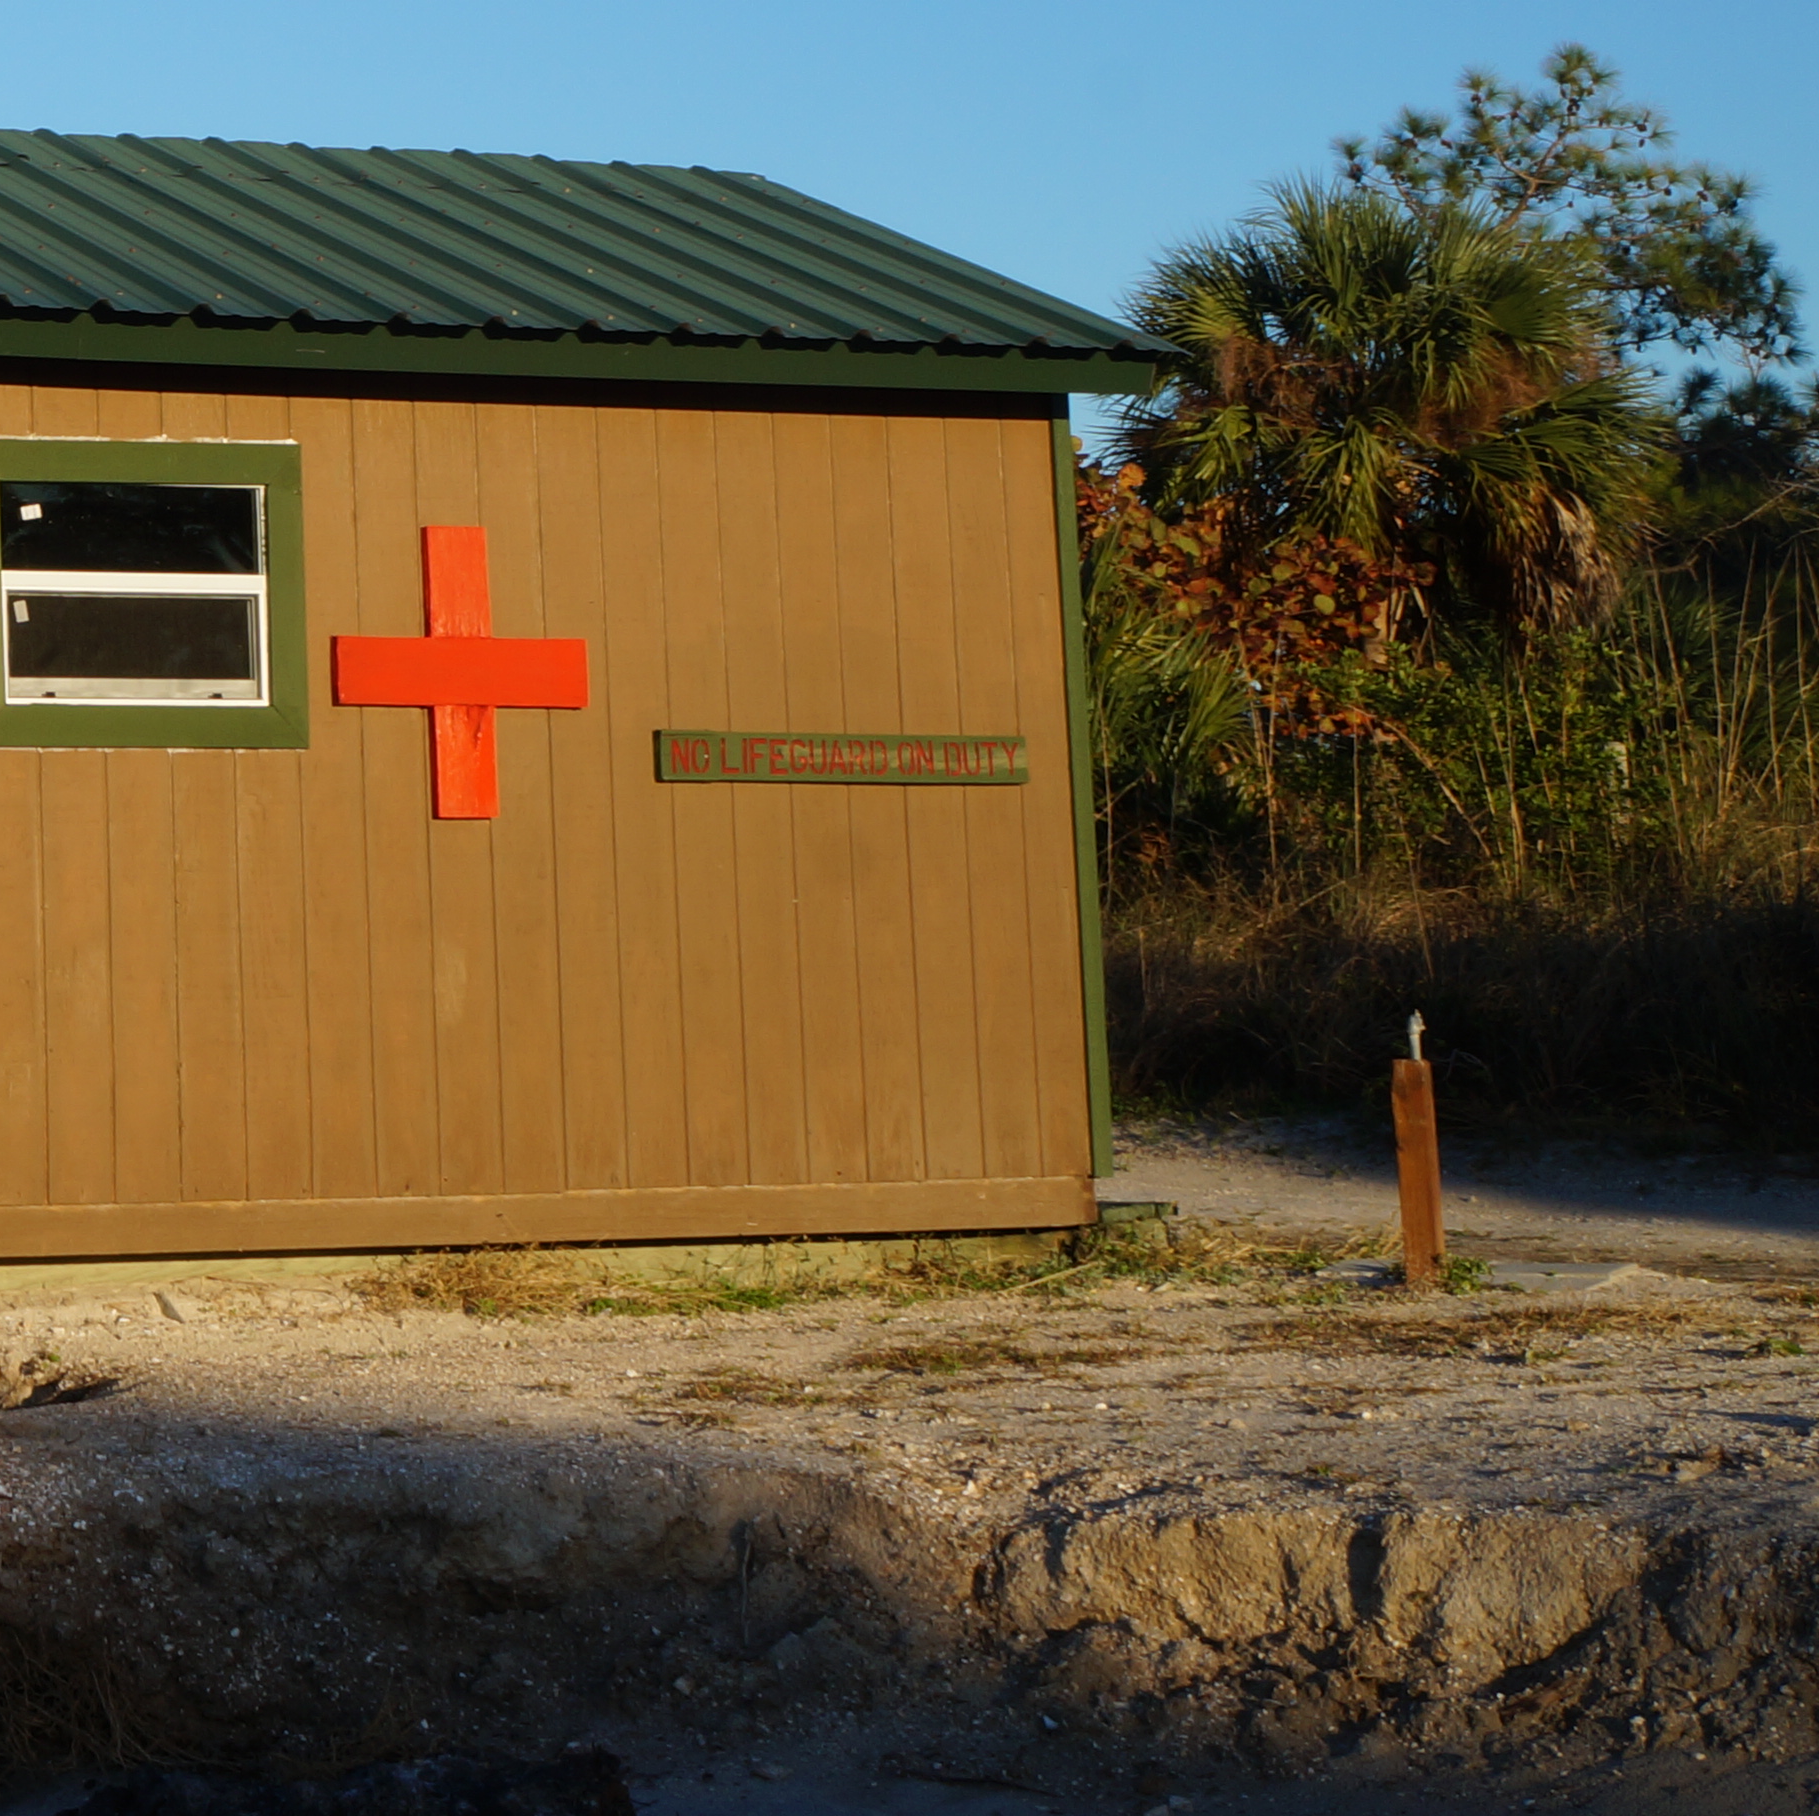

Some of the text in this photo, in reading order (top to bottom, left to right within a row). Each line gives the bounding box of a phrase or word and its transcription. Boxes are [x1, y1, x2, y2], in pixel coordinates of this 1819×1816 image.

[670, 737, 1019, 777] NO LIFEGUARD ON DUTY
